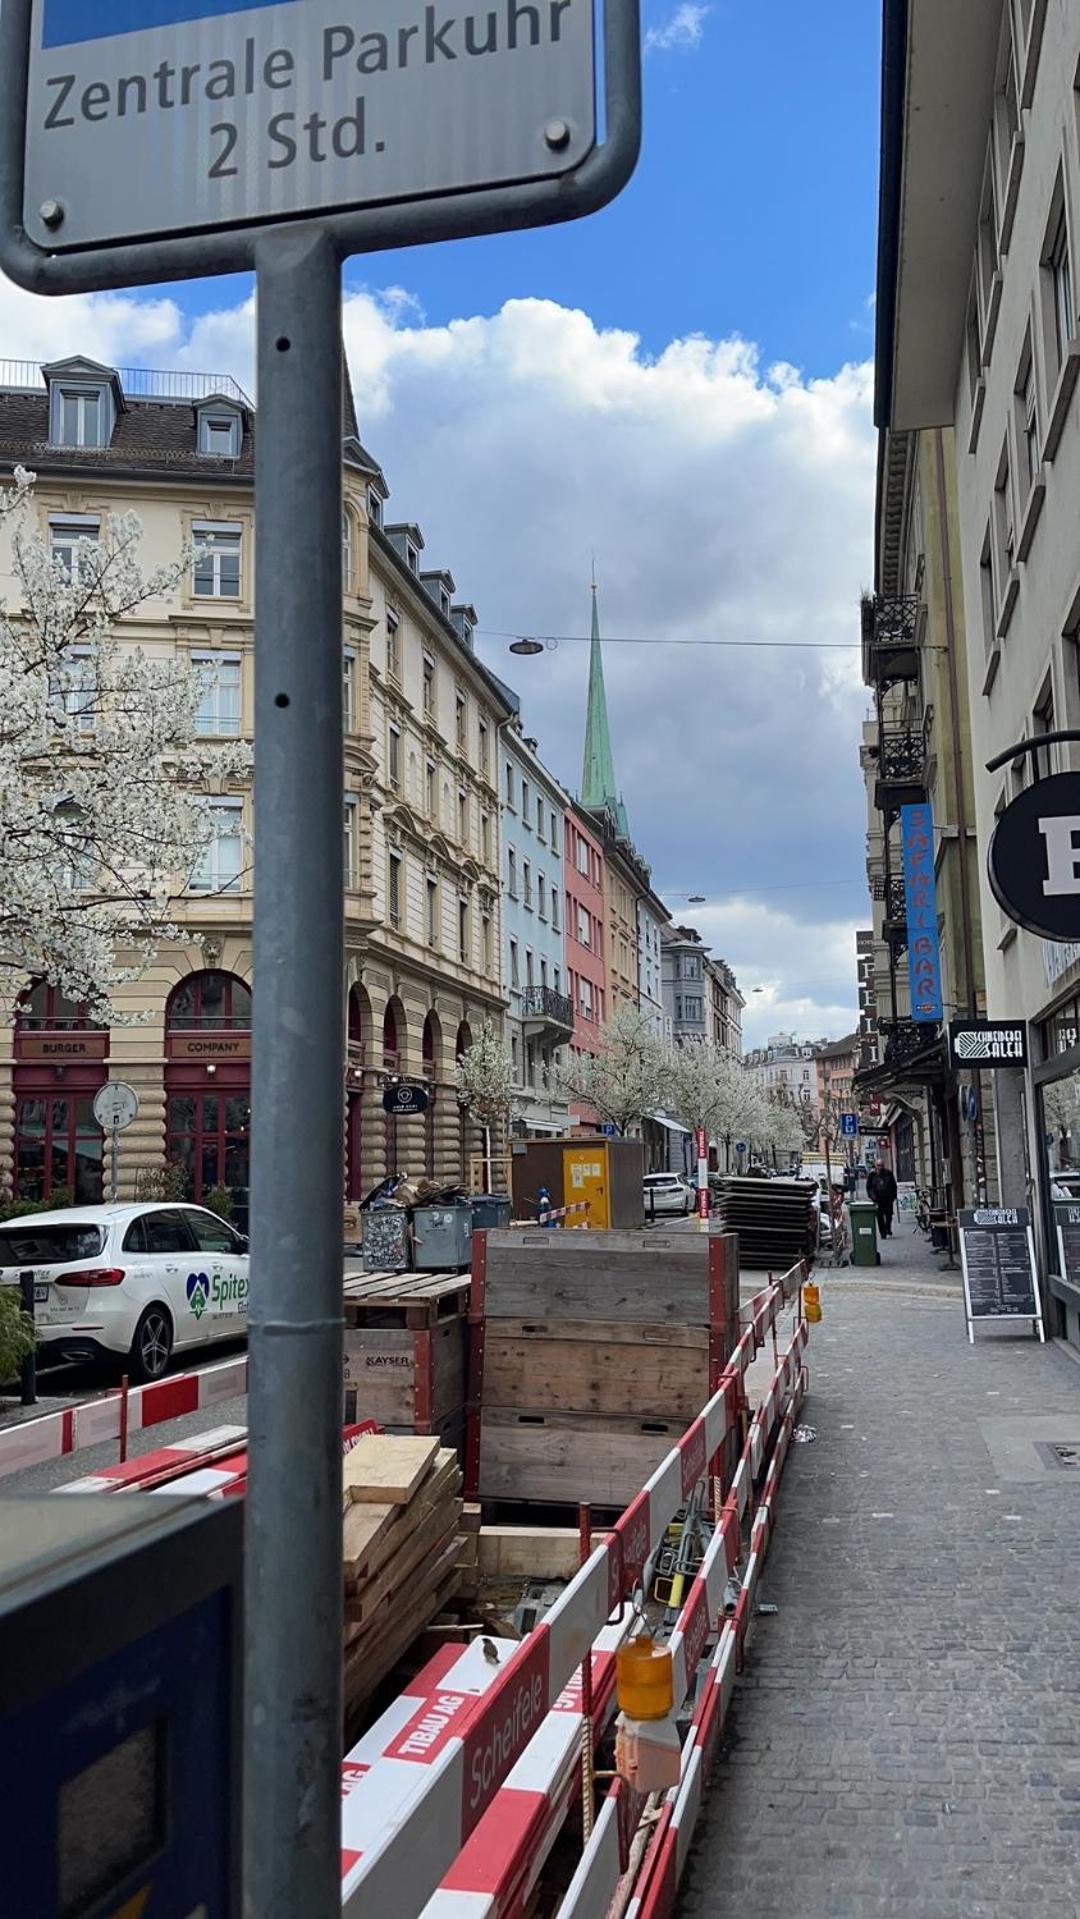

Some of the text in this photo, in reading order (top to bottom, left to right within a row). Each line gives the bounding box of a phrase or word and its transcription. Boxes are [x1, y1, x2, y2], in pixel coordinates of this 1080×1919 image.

[43, 0, 572, 130] Zentrale Parkuhr
[208, 96, 386, 179] 2 Std.
[913, 936, 937, 997] BAR
[42, 1043, 86, 1053] BURGER
[187, 1042, 240, 1053] COMPANY
[397, 1695, 465, 1755] TIBAU AG
